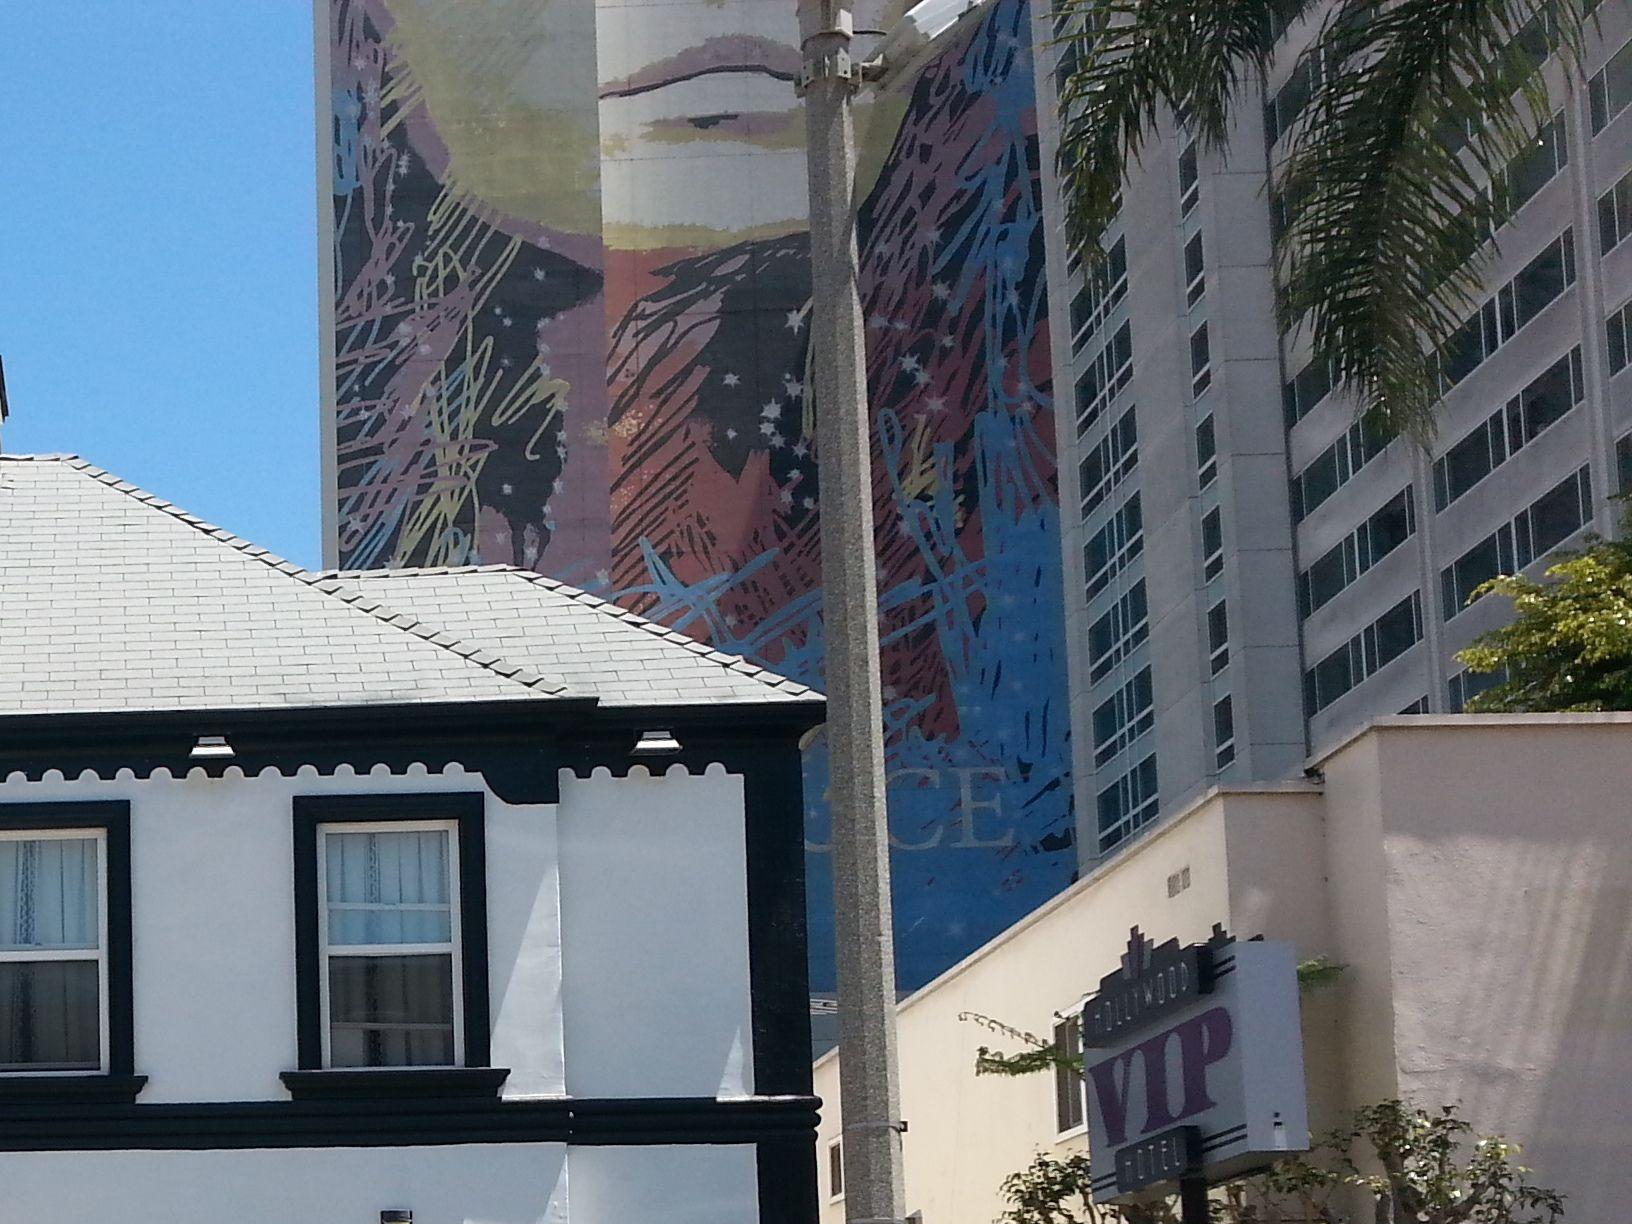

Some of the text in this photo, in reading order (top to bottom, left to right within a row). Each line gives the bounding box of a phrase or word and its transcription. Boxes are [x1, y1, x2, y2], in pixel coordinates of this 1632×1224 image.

[804, 766, 1016, 853] CE
[1088, 1006, 1233, 1148] VIP
[1125, 1135, 1181, 1183] HOTEL
